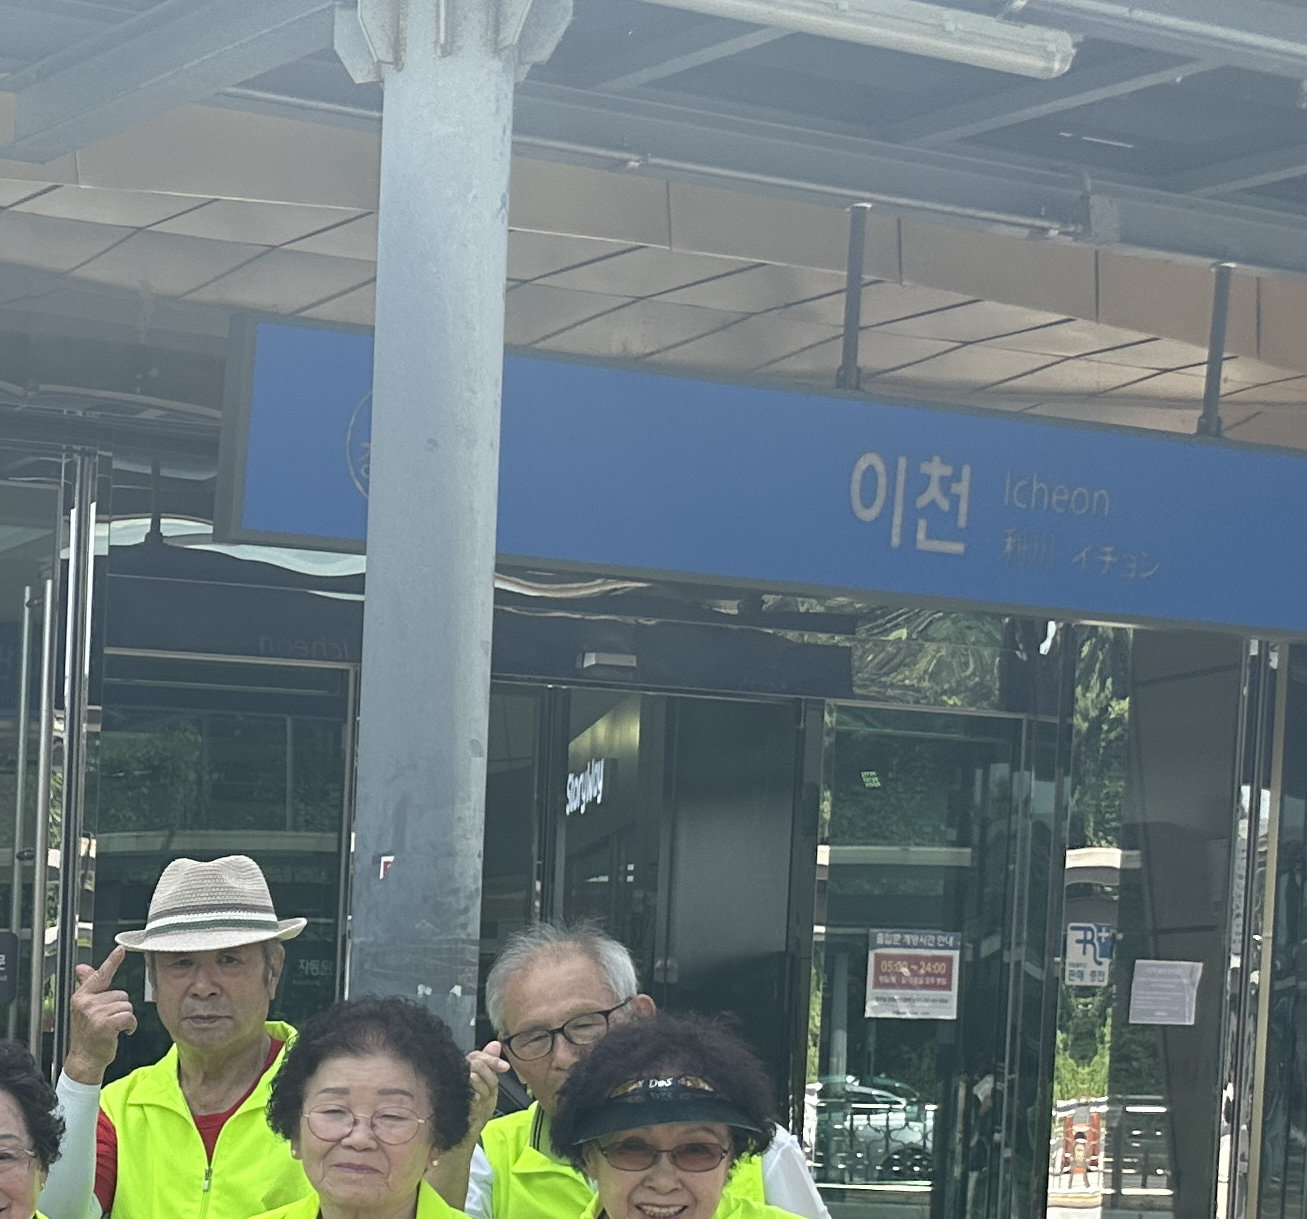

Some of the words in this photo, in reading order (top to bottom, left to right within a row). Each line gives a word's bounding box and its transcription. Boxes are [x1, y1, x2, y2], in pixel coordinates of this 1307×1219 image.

[850, 452, 971, 555] 이천
[1004, 471, 1111, 517] Icheon
[1072, 545, 1161, 579] イチョン
[919, 961, 946, 974] 24:00
